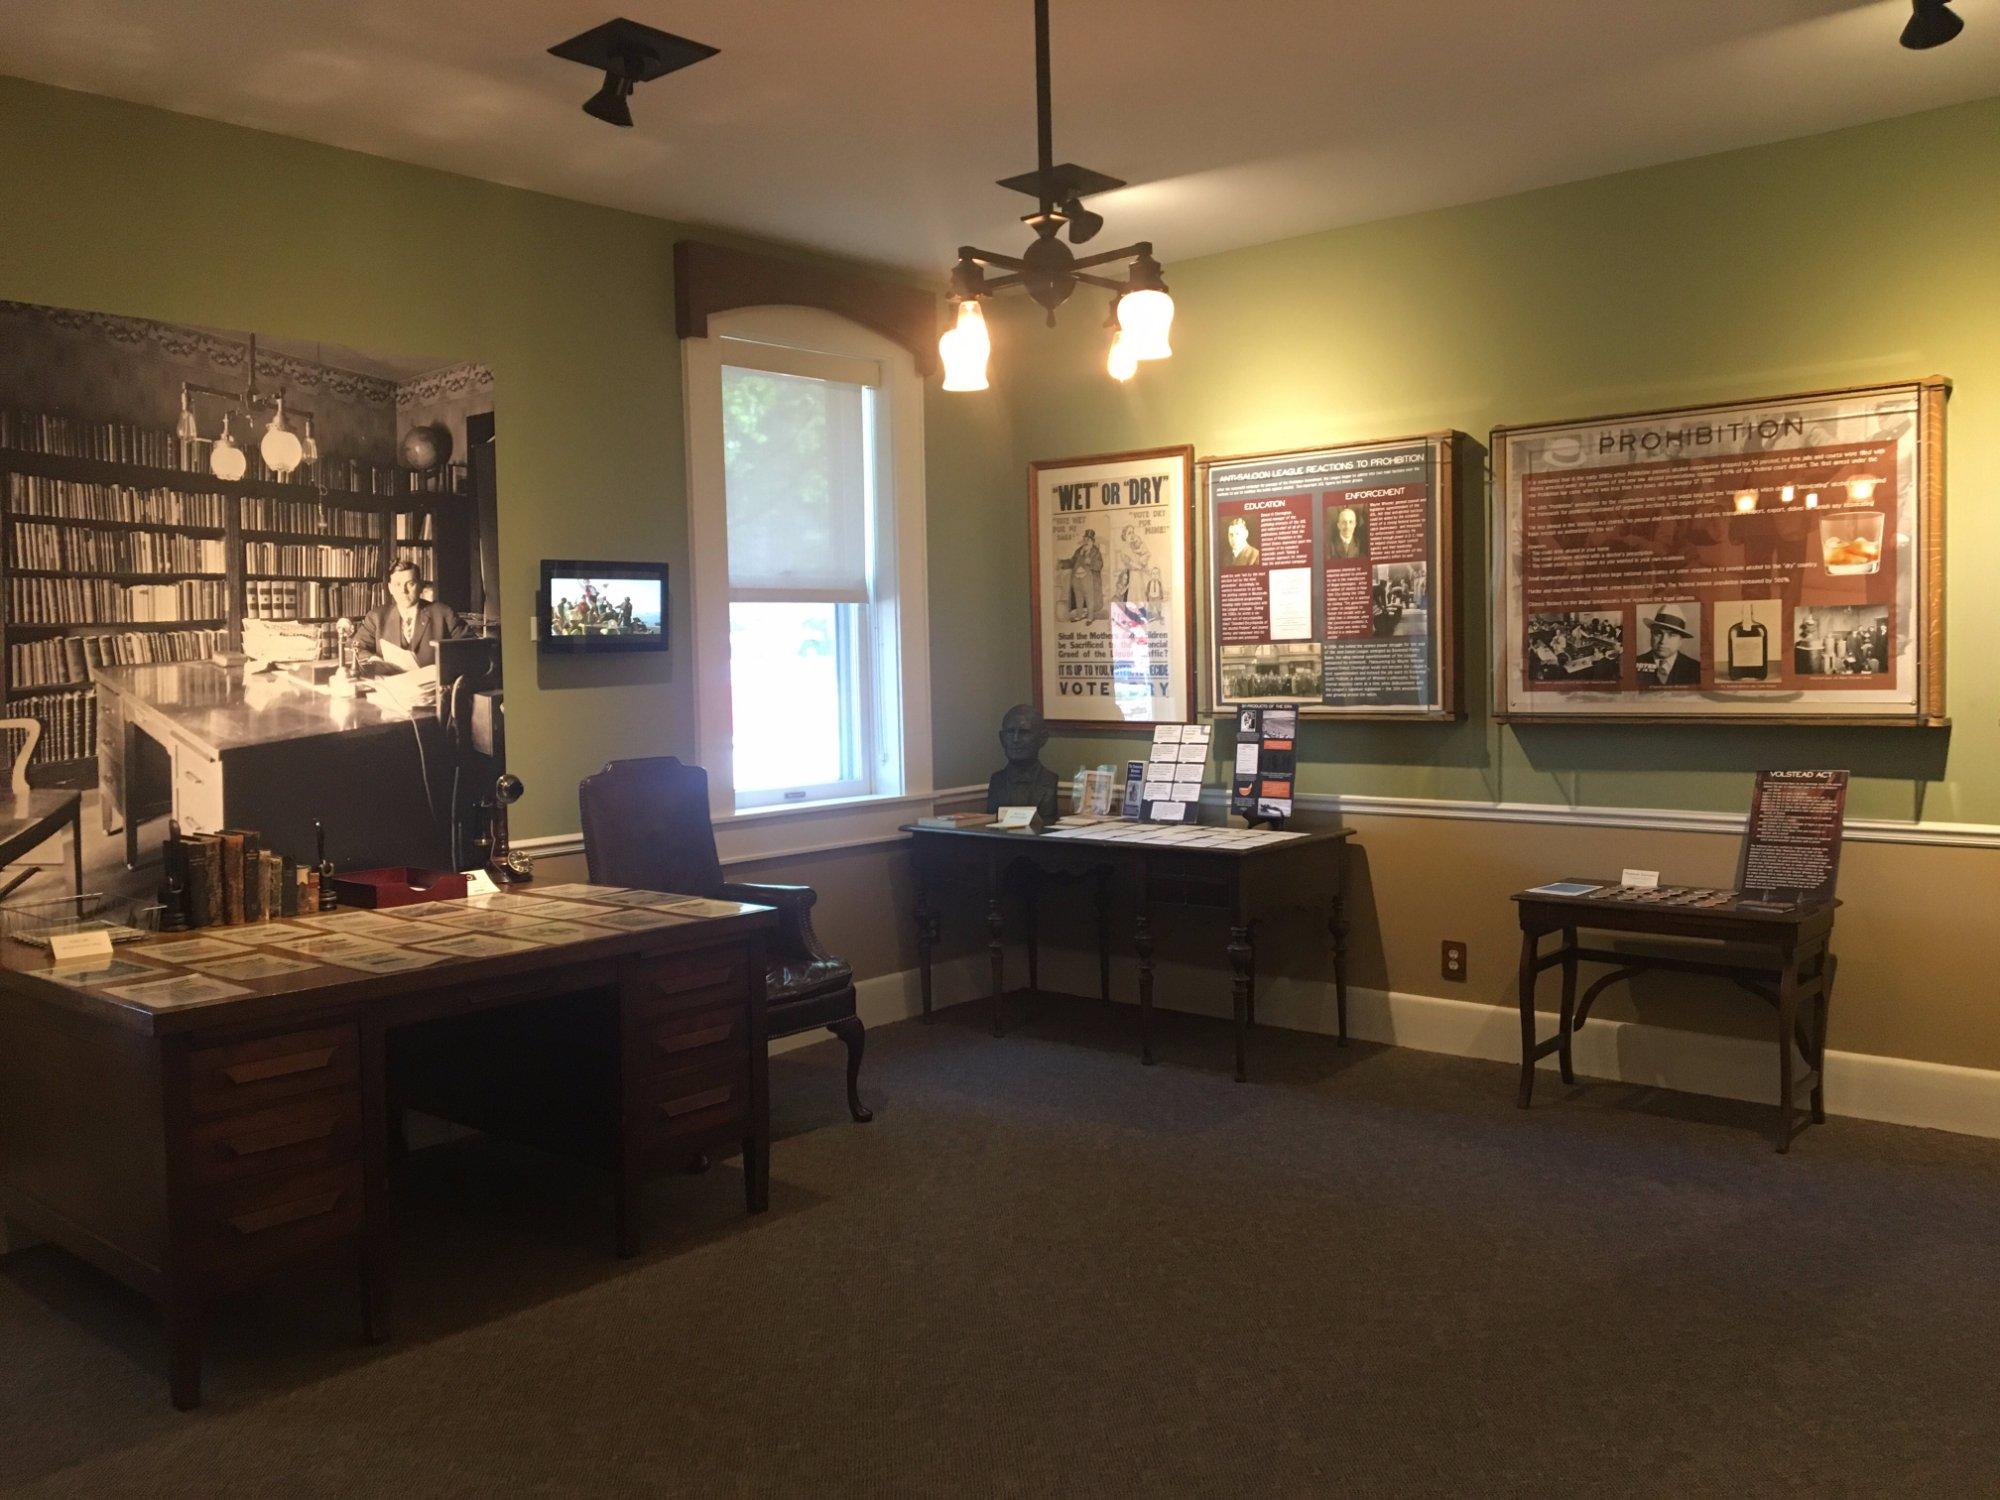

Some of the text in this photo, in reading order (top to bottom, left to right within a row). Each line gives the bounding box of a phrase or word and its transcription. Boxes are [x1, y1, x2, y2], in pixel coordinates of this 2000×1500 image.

[1599, 417, 1803, 454] PROHIBITION
[1219, 453, 1425, 483] ANTI-SALOON LEAGUE REACTIONS TO PROHIBITION
[1101, 482, 1120, 505] OR
[1345, 487, 1406, 500] ENFORCEMENT
[1244, 500, 1286, 511] EDUCATION
[1058, 632, 1074, 640] Shall
[1076, 632, 1088, 640] the
[1058, 641, 1066, 649] be
[1070, 641, 1104, 649] Sacrificed
[1058, 650, 1079, 658] Greed
[1083, 650, 1090, 658] of
[1094, 650, 1106, 658] the
[1059, 664, 1064, 676] IT
[1066, 664, 1073, 676] IS
[1074, 664, 1082, 676] UP
[1085, 664, 1093, 676] TO
[1095, 664, 1110, 677] YOU,
[1060, 682, 1110, 695] VOTE
